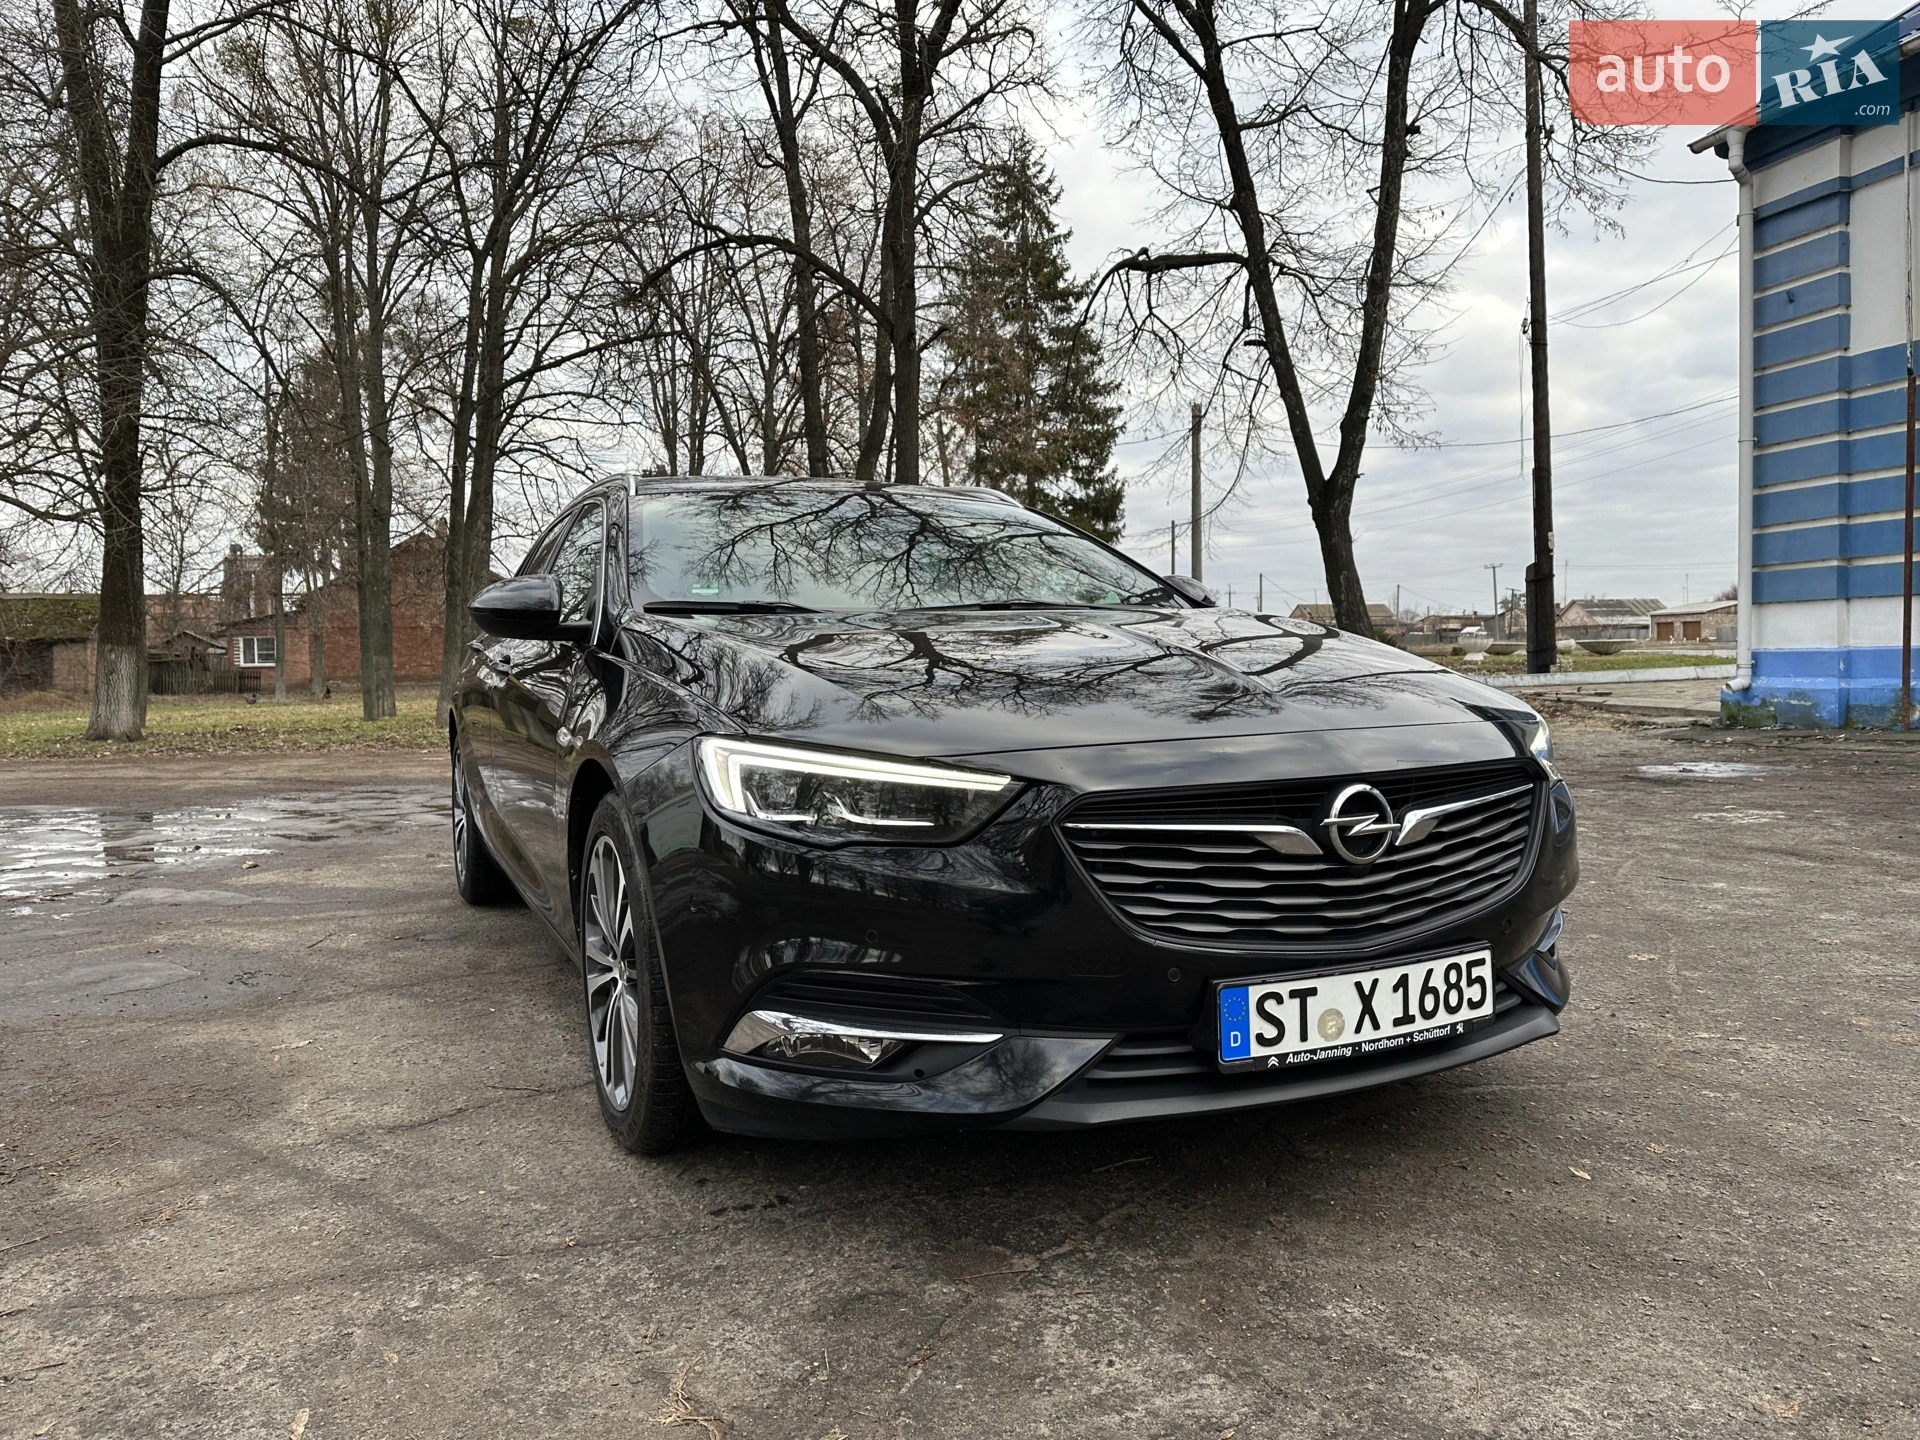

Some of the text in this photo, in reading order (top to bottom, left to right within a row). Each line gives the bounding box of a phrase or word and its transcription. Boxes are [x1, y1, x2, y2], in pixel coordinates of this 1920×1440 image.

[1255, 987, 1318, 1047] ST
[1230, 1031, 1241, 1047] D
[1285, 1045, 1353, 1064] Auto-Janning
[1361, 1036, 1404, 1053] Nordhorn
[1413, 1025, 1451, 1042] Schüttorf
